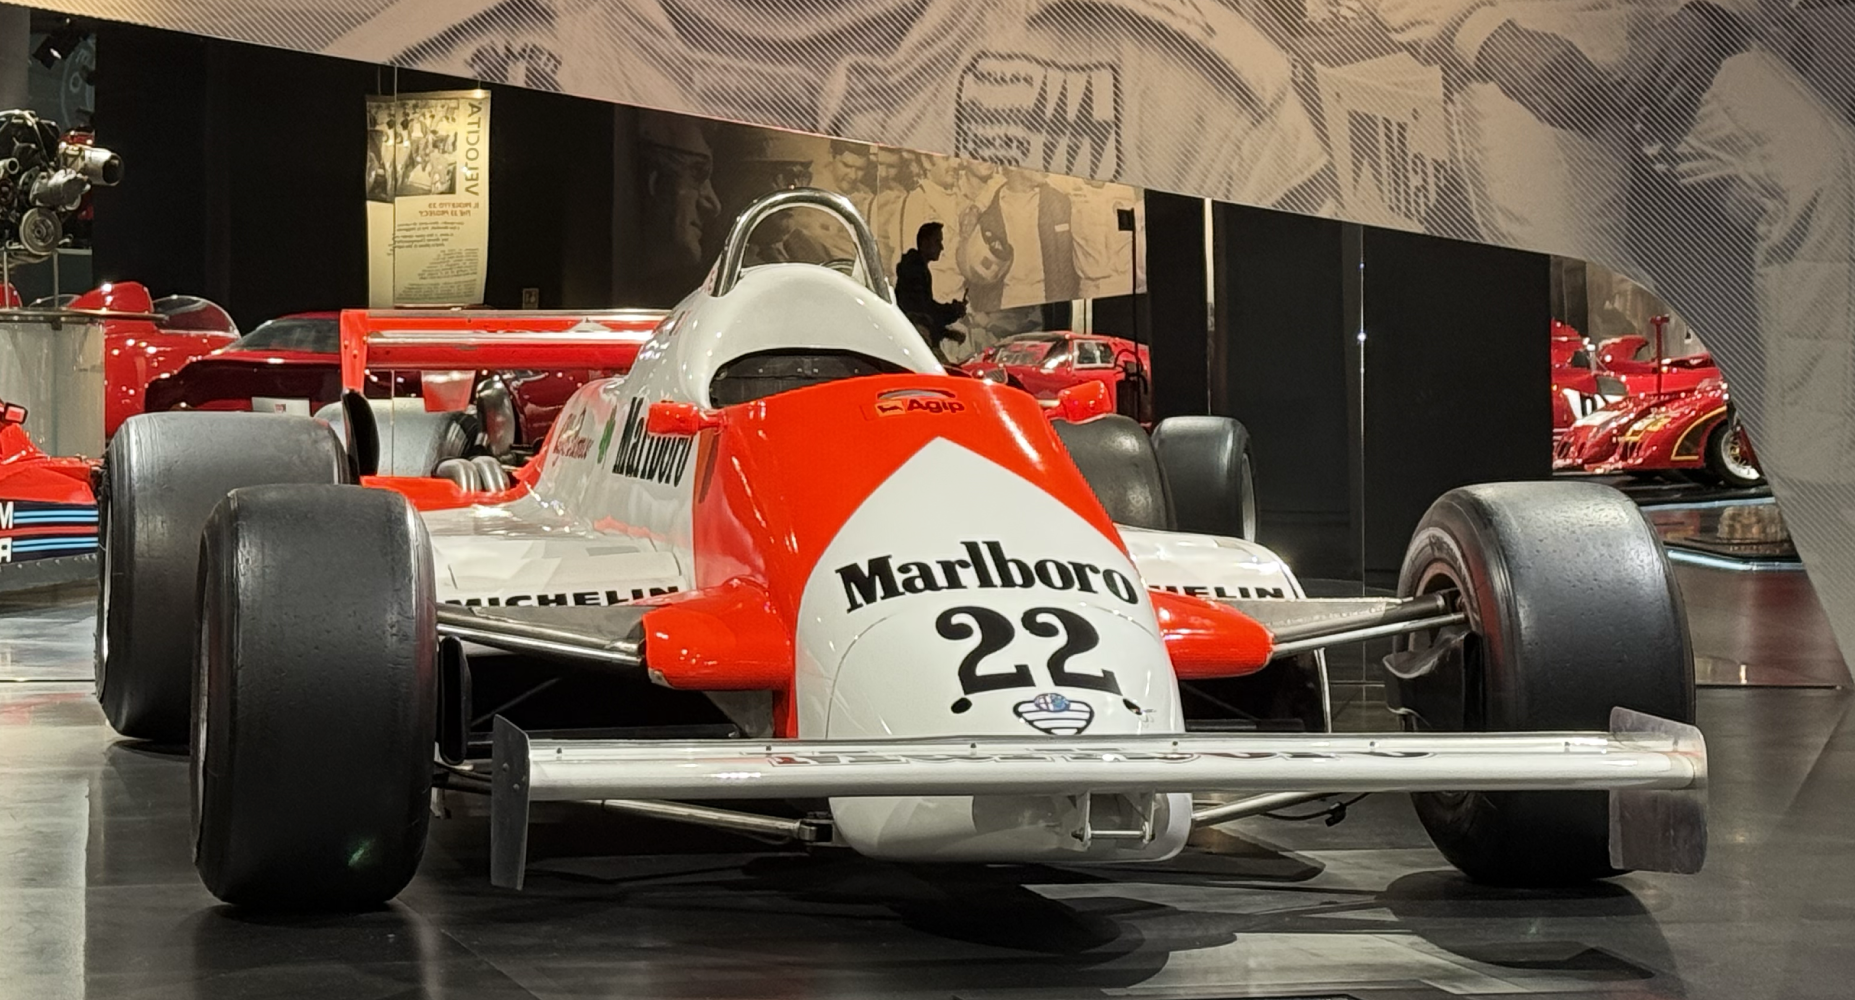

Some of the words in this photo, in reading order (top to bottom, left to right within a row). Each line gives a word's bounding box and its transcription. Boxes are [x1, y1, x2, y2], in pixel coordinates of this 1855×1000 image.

[907, 399, 965, 413] Agip
[834, 540, 1139, 614] Marlboro
[935, 605, 1123, 697] 22
